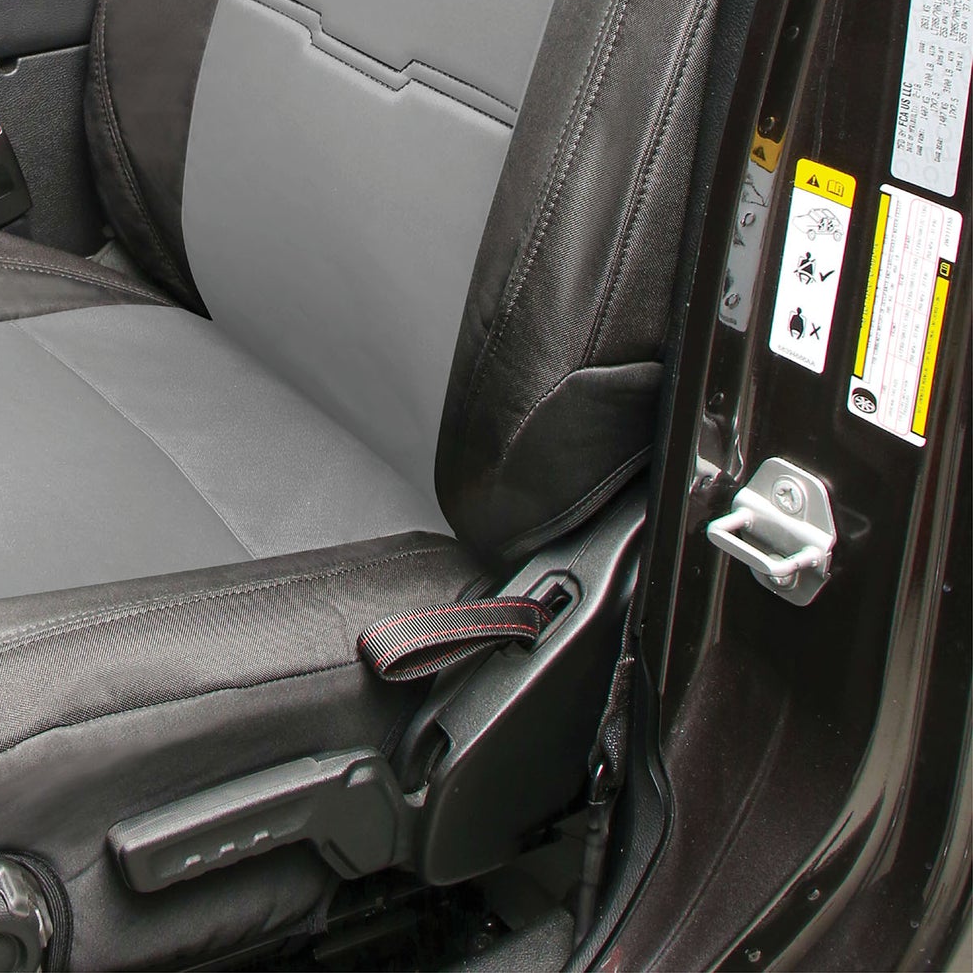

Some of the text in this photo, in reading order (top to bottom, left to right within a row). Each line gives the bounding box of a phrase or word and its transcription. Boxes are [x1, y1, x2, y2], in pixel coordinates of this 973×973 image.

[902, 81, 912, 97] LLC
[901, 97, 910, 110] US
[898, 110, 909, 127] FCA
